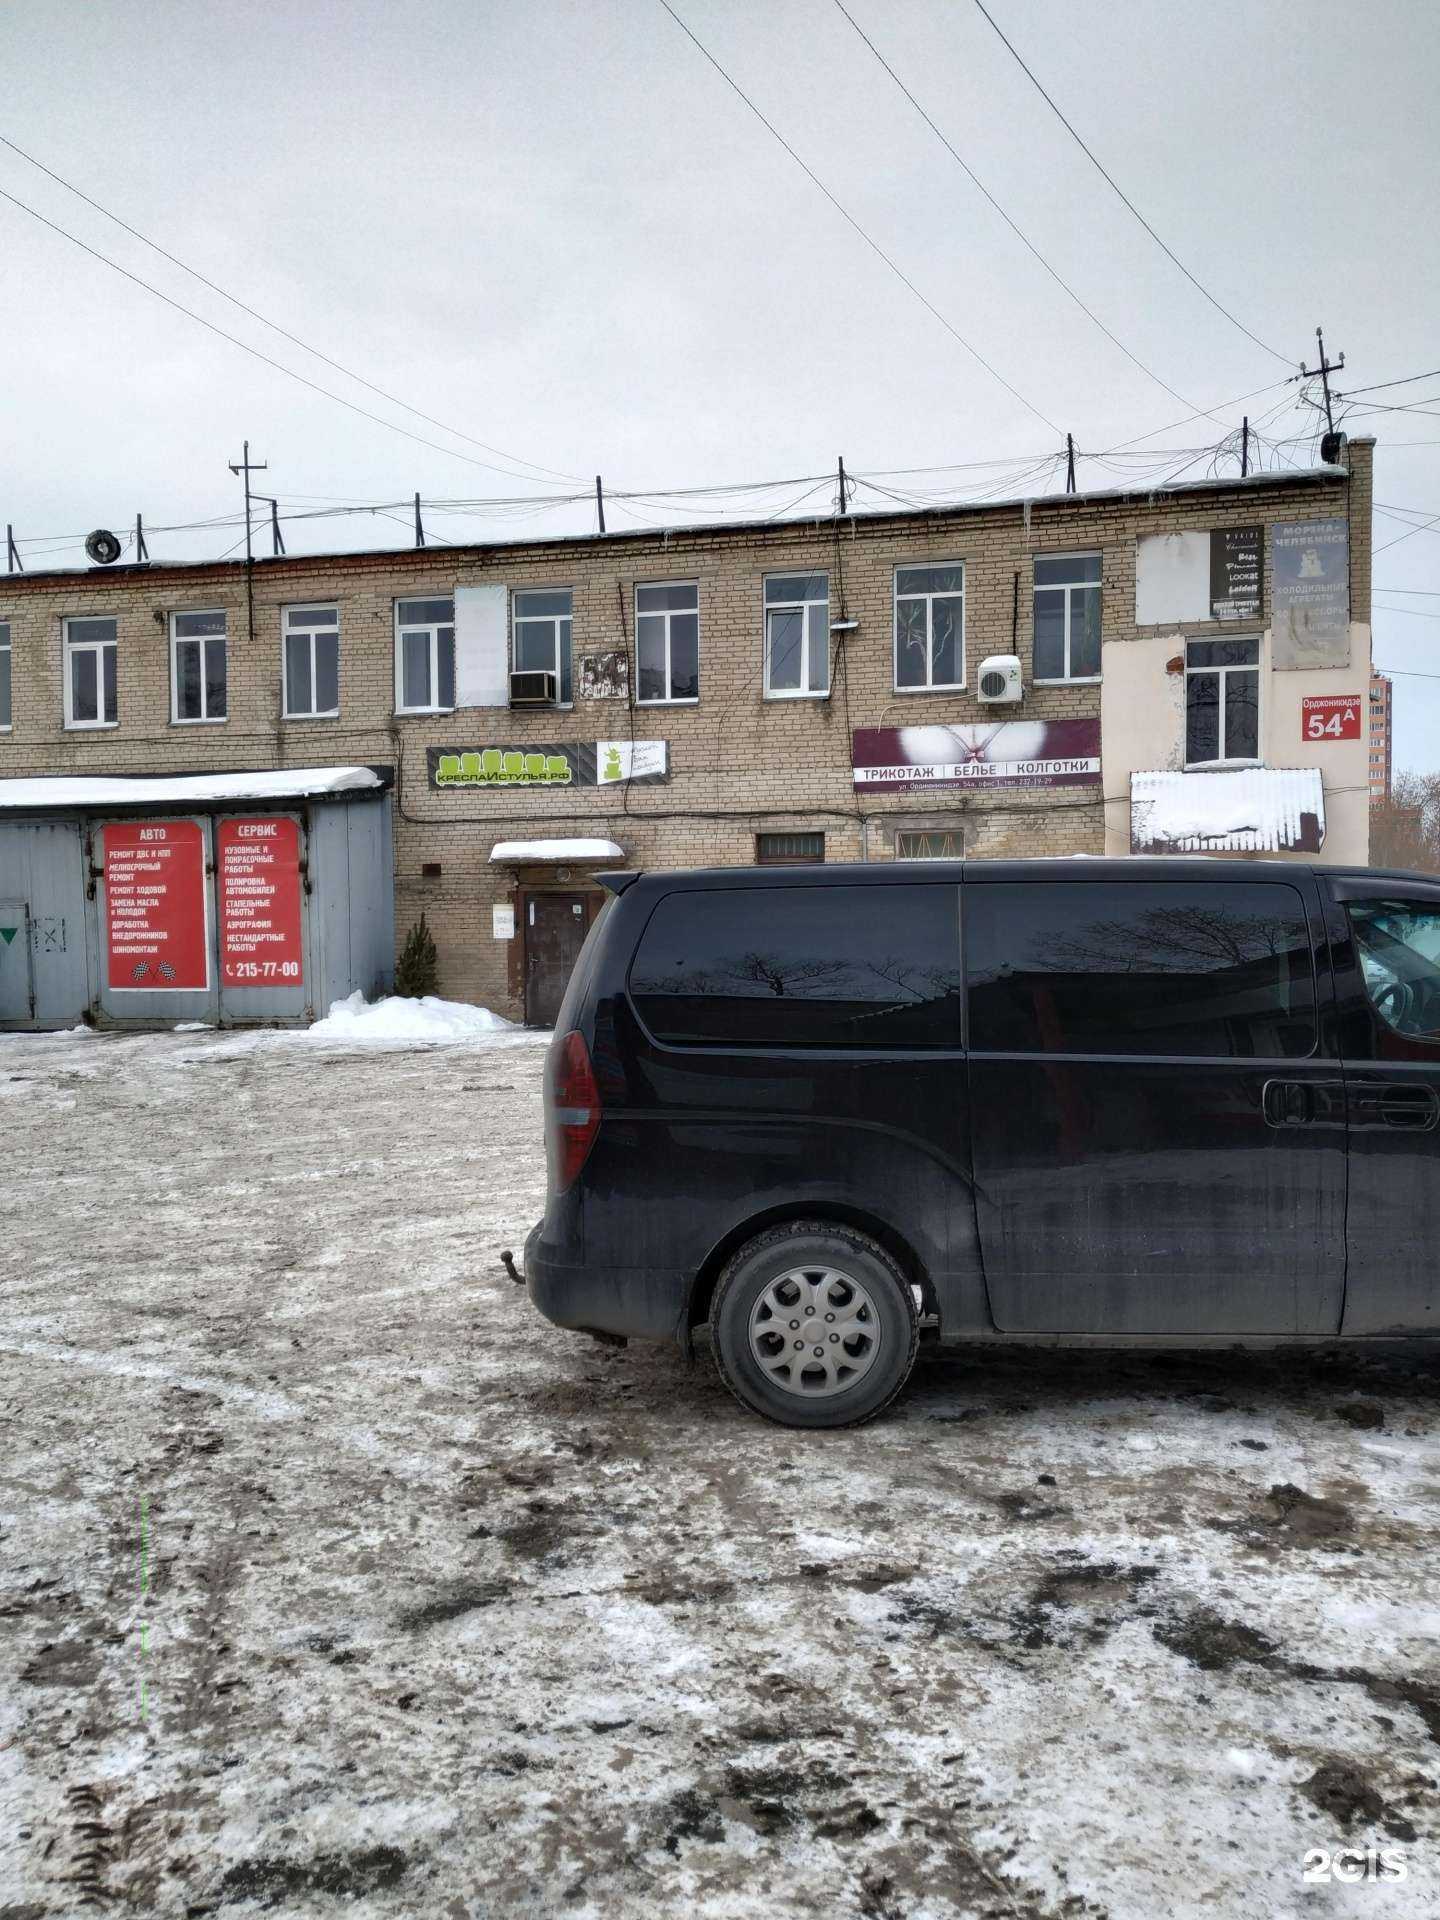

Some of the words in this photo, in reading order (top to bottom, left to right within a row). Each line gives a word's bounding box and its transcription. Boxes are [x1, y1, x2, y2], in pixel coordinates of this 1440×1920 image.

[1303, 698, 1361, 710] Орджоникидзе
[863, 767, 934, 780] ТРИКОТАЖ
[954, 764, 997, 777] БЕЛЬЕ
[1017, 760, 1089, 774] КОЛГОТКИ
[140, 828, 166, 841] АВТО
[238, 824, 277, 837] СЕРВИС
[109, 850, 135, 859] РЕМОНТ
[136, 850, 150, 859] ДВС
[224, 845, 261, 855] КУЗОВНЫЕ
[224, 855, 275, 864] ПОКРАСОЧНЫЕ
[224, 865, 253, 874] РАБОТЫ
[109, 873, 135, 882] РЕМОНТ
[225, 877, 266, 886] ПОЛИРОВКА
[110, 886, 135, 895] РЕМОНТ
[136, 884, 167, 895] ХОДОВОЙ
[225, 885, 275, 895] АВТОМОБИЛЕЙ
[110, 898, 135, 907] ЗАМЕНА
[137, 898, 159, 906] МАСЛА
[226, 899, 271, 908] СТАПЕЛЬНЫЕ
[225, 908, 255, 917] РАБОТЫ
[111, 920, 149, 930] ДОРАБОТКА
[226, 920, 272, 929] АЭРОГРАФИЯ
[112, 932, 168, 941] ВНЕДОРОЖНИКОВ
[227, 933, 286, 943] НЕСТАНДАРТНЫЕ
[112, 945, 158, 954] ШИНОМОНТАЖ
[227, 943, 256, 952] РАБОТЫ
[236, 962, 298, 978] 215-77-00
